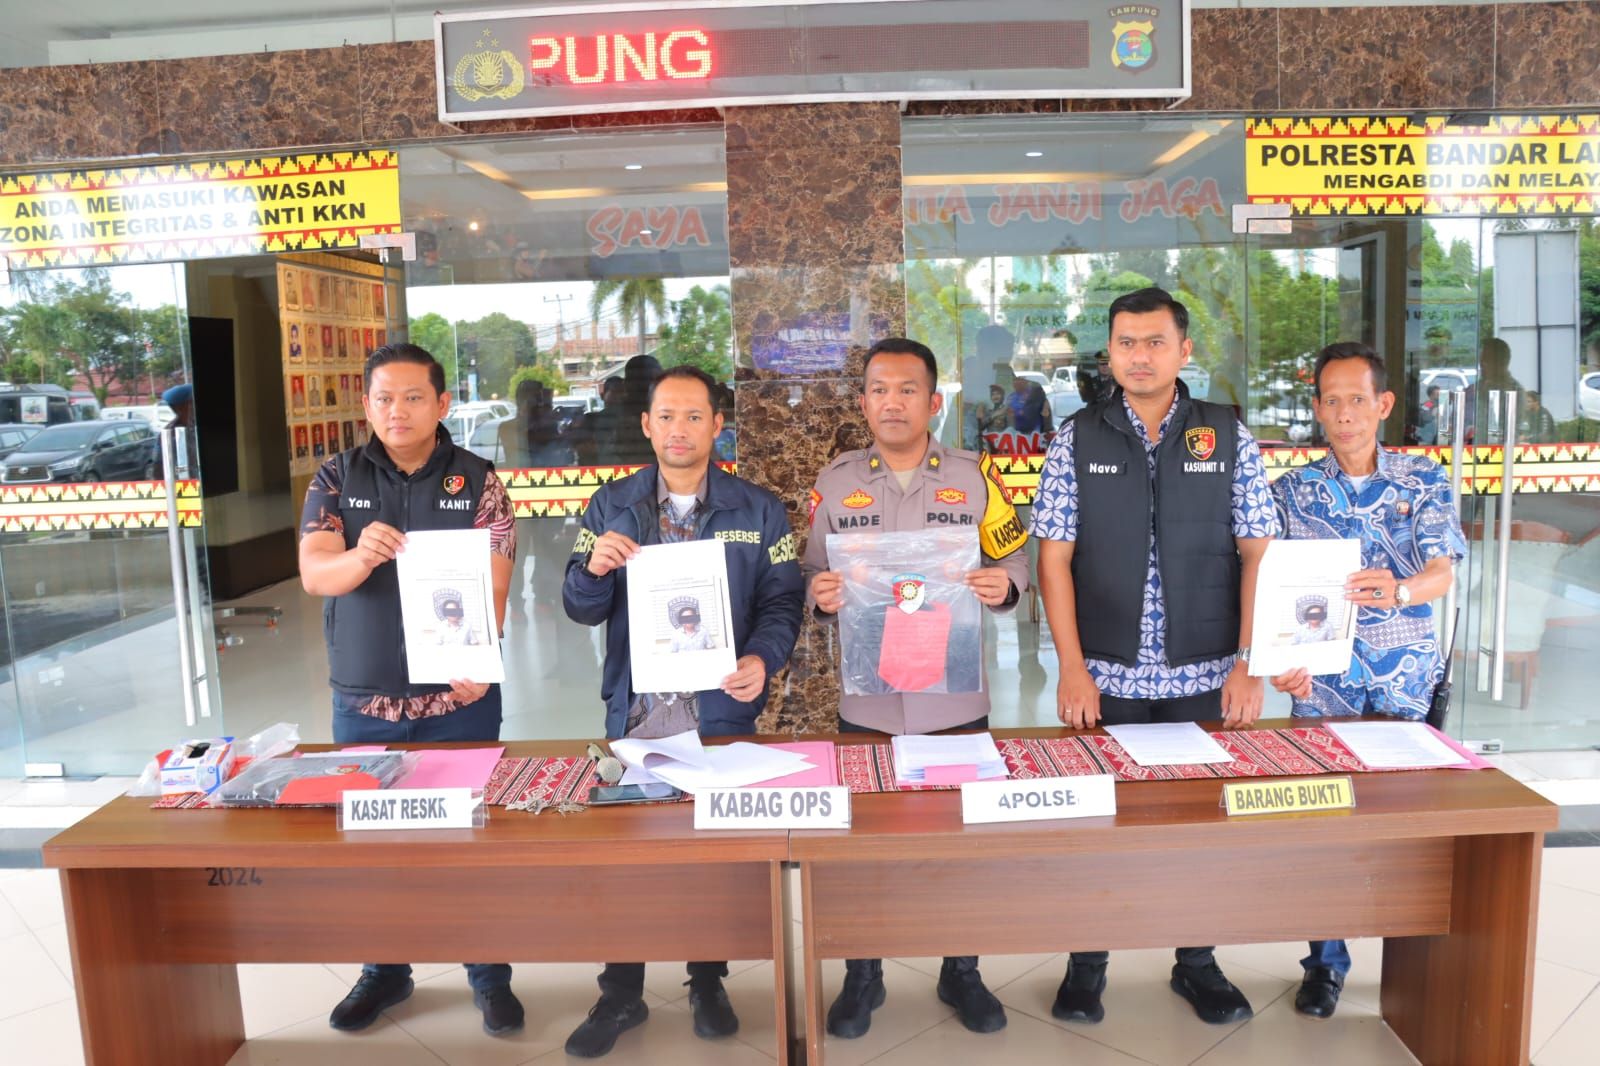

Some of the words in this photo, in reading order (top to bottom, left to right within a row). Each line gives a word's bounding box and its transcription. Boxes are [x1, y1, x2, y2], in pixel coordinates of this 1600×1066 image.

[1110, 6, 1157, 17] LAMPUNG
[1262, 143, 1416, 166] POLRESTA
[1425, 143, 1547, 165] BANDAR
[1558, 142, 1600, 165] LA
[1323, 173, 1453, 189] MENGABDI
[1460, 172, 1510, 188] DAN
[1518, 172, 1600, 188] MELAY
[15, 196, 80, 219] ANDA
[87, 189, 215, 214] MEMASUKI
[224, 179, 346, 205] KAWASAN
[0, 223, 64, 243] ZONA
[71, 214, 214, 241] INTEGRITAS
[222, 212, 239, 229] &
[248, 206, 304, 227] ANTI
[313, 202, 366, 222] KKN
[587, 205, 711, 258] SAYA
[904, 184, 975, 225] ITA
[988, 181, 1105, 227] JANJI
[1119, 176, 1229, 223] JAGA
[1089, 462, 1118, 474] Navo
[348, 497, 371, 509] Yan
[439, 499, 471, 511] KANIT
[838, 514, 881, 529] MADE
[926, 512, 973, 525] POLRI
[714, 530, 760, 544] RESERSE
[767, 533, 798, 566] RESE
[710, 791, 783, 817] KABAG
[790, 791, 832, 817] OPS
[998, 789, 1080, 809] APOLSE
[1234, 786, 1294, 810] BARANG
[1297, 783, 1343, 806] BUKTI
[351, 799, 397, 821] KASAT
[205, 867, 263, 887] 2024
